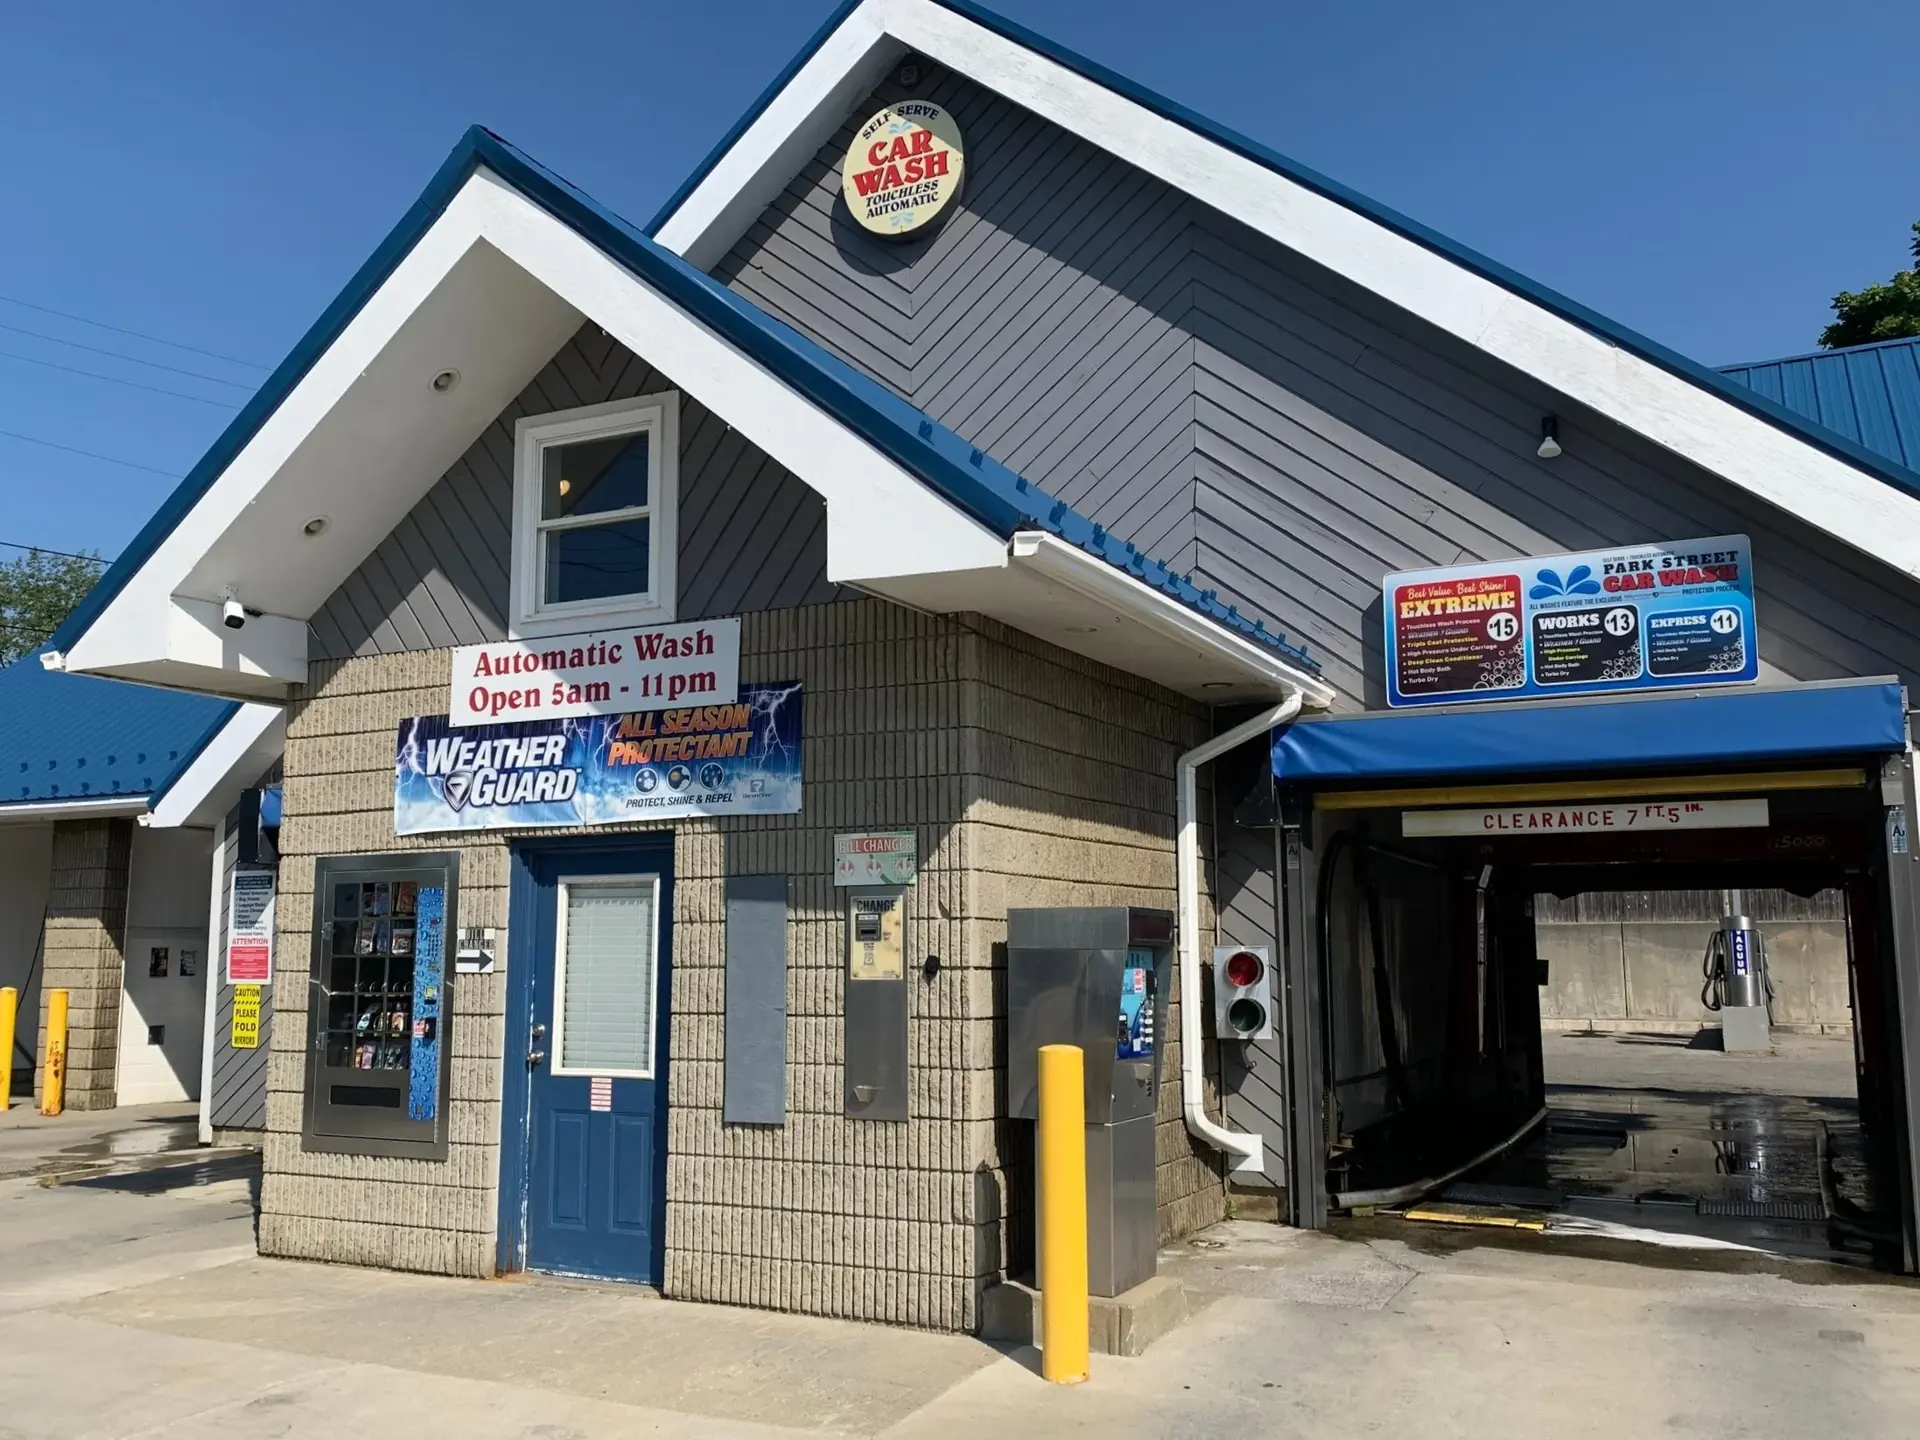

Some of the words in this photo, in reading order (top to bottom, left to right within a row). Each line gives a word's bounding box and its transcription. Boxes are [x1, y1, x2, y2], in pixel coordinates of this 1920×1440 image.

[862, 111, 892, 140] SELF
[897, 104, 939, 120] SERVE
[868, 130, 933, 166] CAR
[852, 150, 949, 196] WASH
[866, 180, 938, 208] TOUCHLESS
[866, 192, 939, 218] AUTOMATIC
[1604, 560, 1654, 574] PARK
[1662, 551, 1738, 568] STREET
[1603, 572, 1656, 592] CAR
[1658, 564, 1738, 586] WASH
[1408, 588, 1426, 600] Best
[1457, 582, 1477, 594] Best
[1479, 580, 1507, 592] Shine!
[1682, 587, 1714, 595] PROTECTION
[1400, 591, 1515, 618] EXTREME
[1489, 618, 1514, 637] $15
[1538, 614, 1600, 630] WORKS
[1606, 614, 1630, 632] $13
[1651, 615, 1706, 628] EXPRESS
[473, 640, 622, 677] Automatic
[634, 629, 714, 661] Wash
[469, 686, 541, 716] Open
[551, 682, 610, 706] 5am
[641, 671, 716, 701] 11pm
[616, 712, 656, 738] ALL
[661, 704, 751, 734] SEASON
[425, 734, 567, 775] WEATHER
[607, 732, 753, 766] PROTECTANT
[470, 767, 576, 806] GUARD
[626, 797, 665, 808] PROTECT,
[667, 794, 694, 805] SHINE
[695, 795, 702, 804] &
[705, 793, 733, 803] REPEL
[1484, 810, 1614, 829] CLEARANCE
[1627, 810, 1638, 825] 7
[1645, 806, 1664, 818] FT.
[1668, 808, 1680, 823] 5
[1685, 803, 1704, 812] IN.
[839, 841, 860, 853] BILL
[863, 838, 914, 852] CHANGER
[856, 900, 896, 912] CHANGE
[466, 929, 484, 940] BILL
[235, 988, 260, 997] CAUTION
[235, 1009, 257, 1018] PLEASE
[235, 1022, 256, 1031] FOLD
[234, 1036, 255, 1045] MIRRORS
